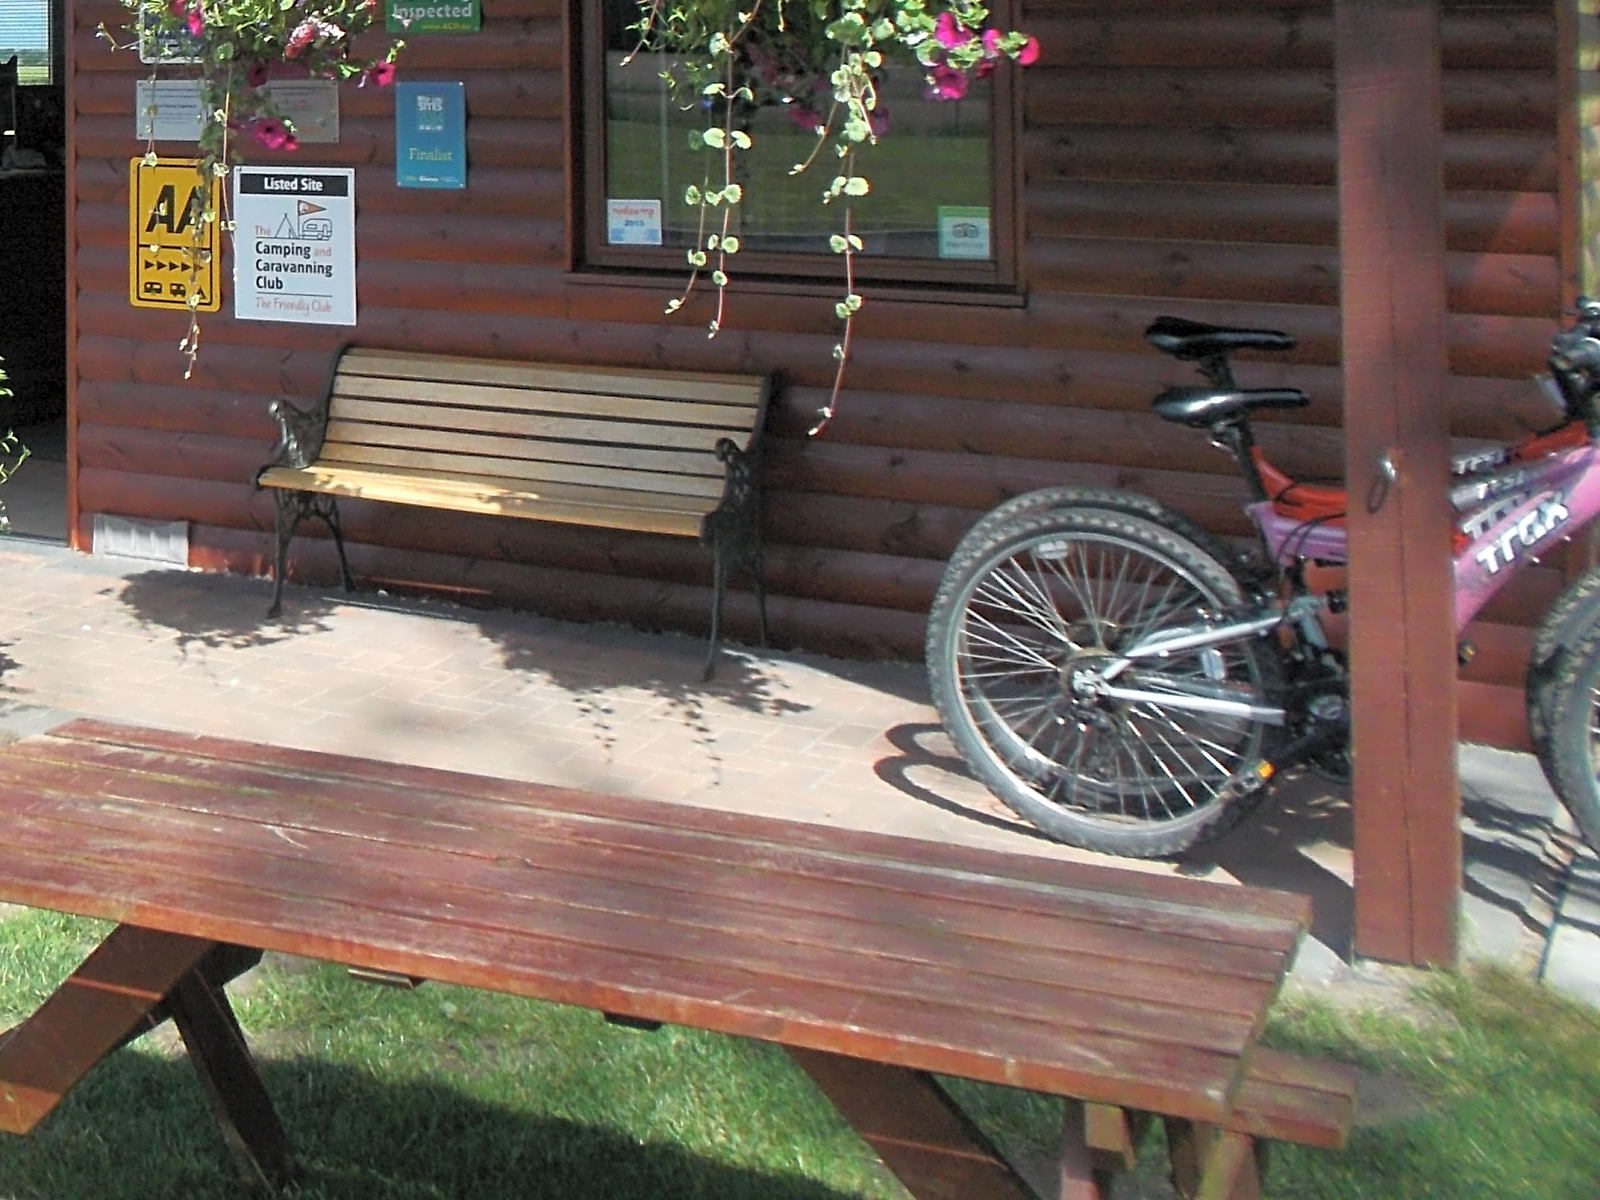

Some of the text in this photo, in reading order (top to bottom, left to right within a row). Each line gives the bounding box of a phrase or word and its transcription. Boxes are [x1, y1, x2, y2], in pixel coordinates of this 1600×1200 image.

[393, 3, 472, 20] Inspected
[409, 146, 453, 162] Finalist
[263, 176, 323, 192] Listed Site
[255, 225, 272, 236] The
[255, 241, 332, 260] Camping and
[255, 259, 333, 278] Caravanning
[255, 275, 284, 290] Club
[255, 297, 333, 315] The Friendly Club
